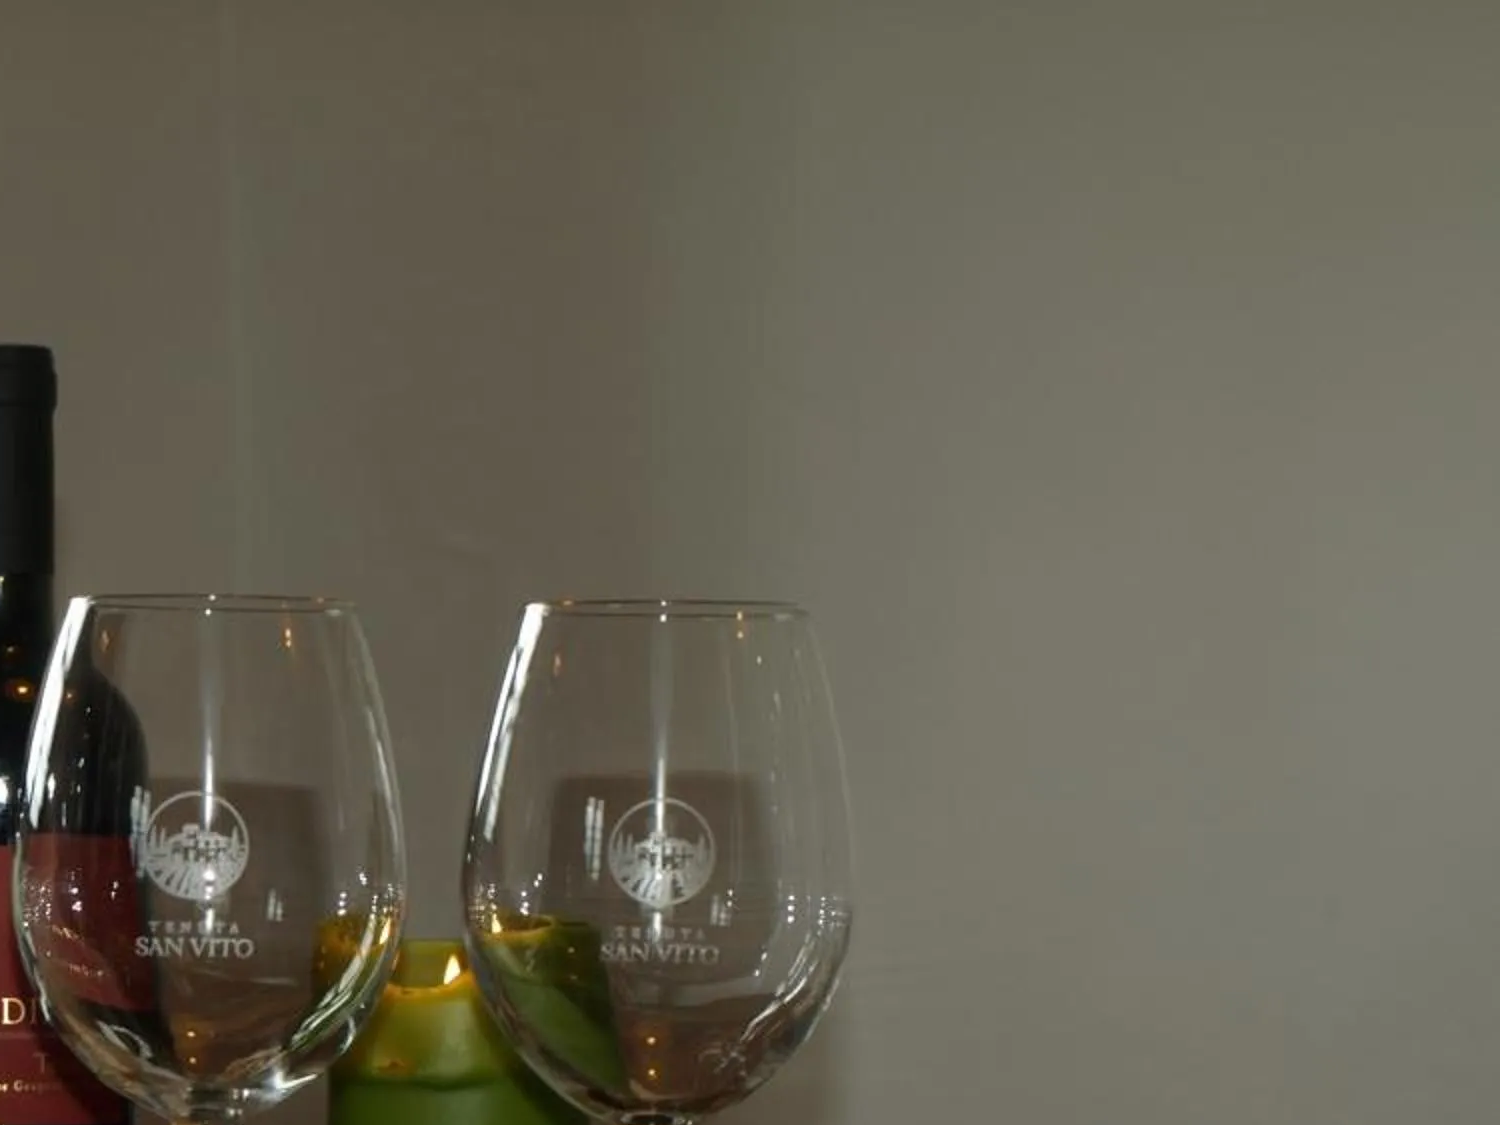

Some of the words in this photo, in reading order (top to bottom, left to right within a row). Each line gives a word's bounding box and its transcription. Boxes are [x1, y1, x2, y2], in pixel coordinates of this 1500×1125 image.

[135, 936, 183, 957] SAN
[189, 937, 255, 958] VITO
[601, 942, 649, 963] SAN
[655, 943, 720, 964] VITO
